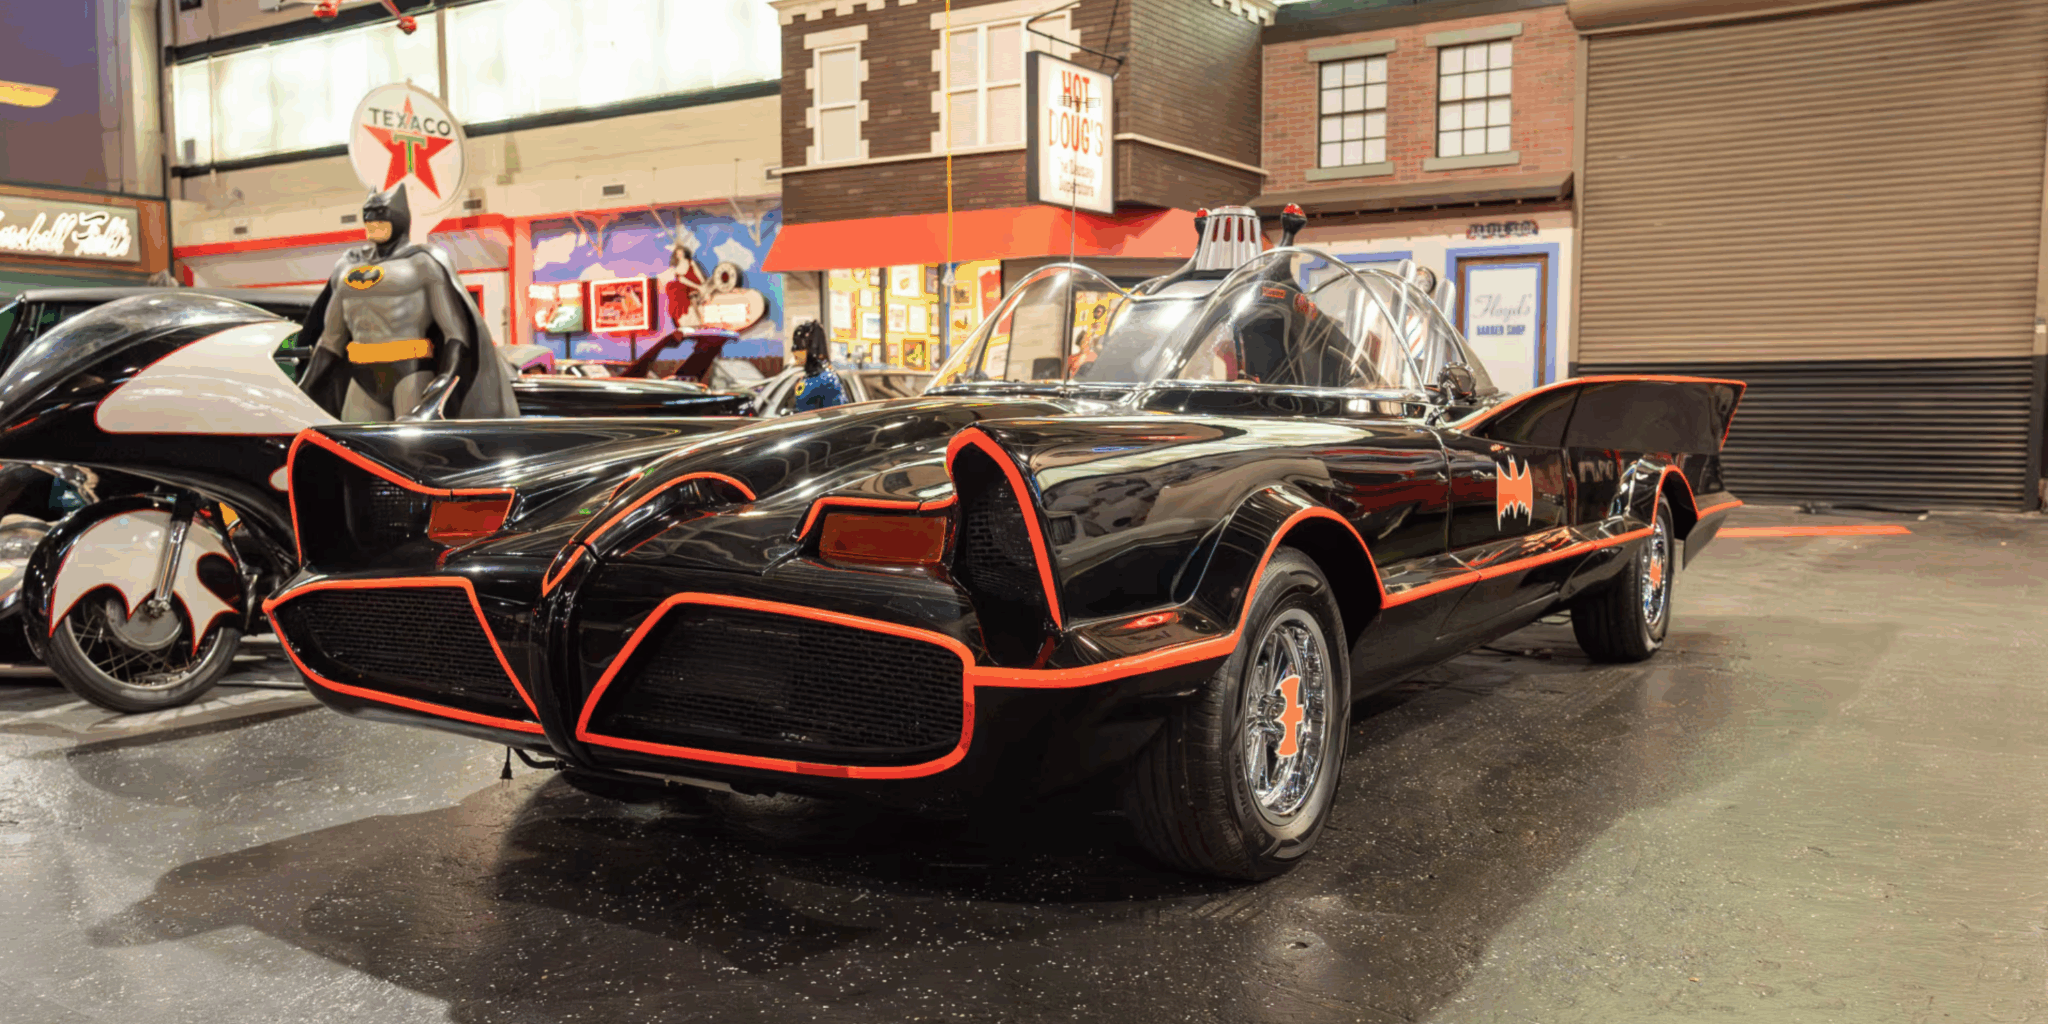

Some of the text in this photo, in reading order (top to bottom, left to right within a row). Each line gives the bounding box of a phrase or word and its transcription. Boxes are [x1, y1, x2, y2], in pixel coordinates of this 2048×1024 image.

[1061, 70, 1090, 113] HOT
[368, 107, 451, 136] TEXACO
[1049, 108, 1104, 158] DOUG'S
